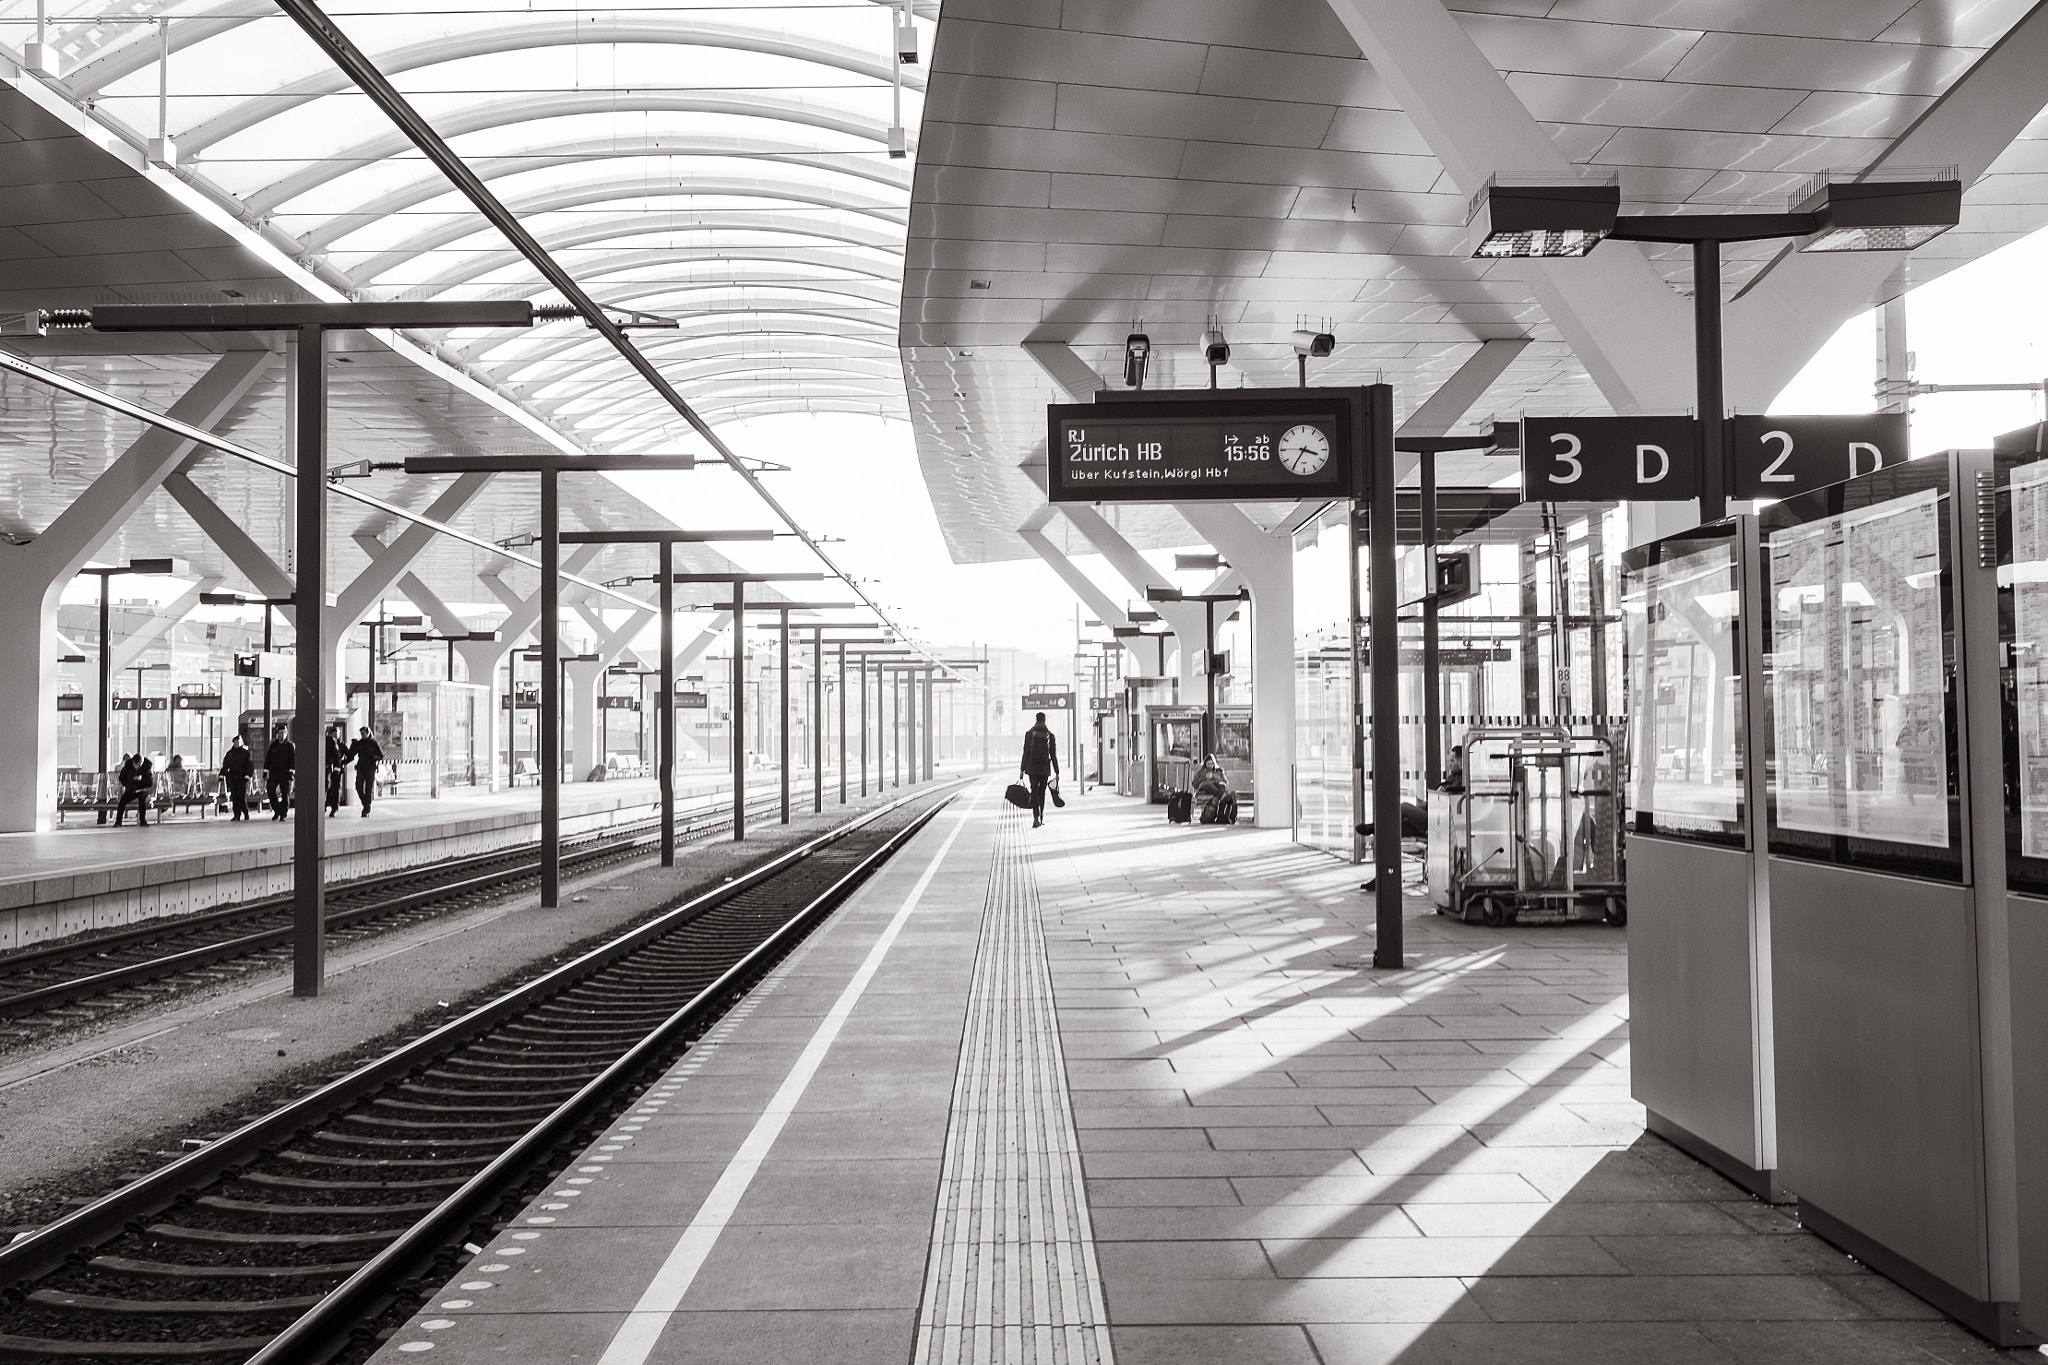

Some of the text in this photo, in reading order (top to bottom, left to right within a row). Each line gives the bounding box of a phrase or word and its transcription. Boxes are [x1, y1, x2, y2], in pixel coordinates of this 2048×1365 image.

[1068, 430, 1085, 443] RJ
[1255, 434, 1270, 444] ab
[1069, 442, 1162, 462] Zürich HB
[1224, 445, 1270, 461] 15:56
[1759, 430, 1884, 483] 2 D
[1548, 432, 1670, 485] 3 D
[1206, 467, 1229, 478] Hbf
[114, 700, 120, 709] 7
[146, 699, 152, 709] 6
[610, 698, 617, 707] 4
[1092, 698, 1100, 709] 3
